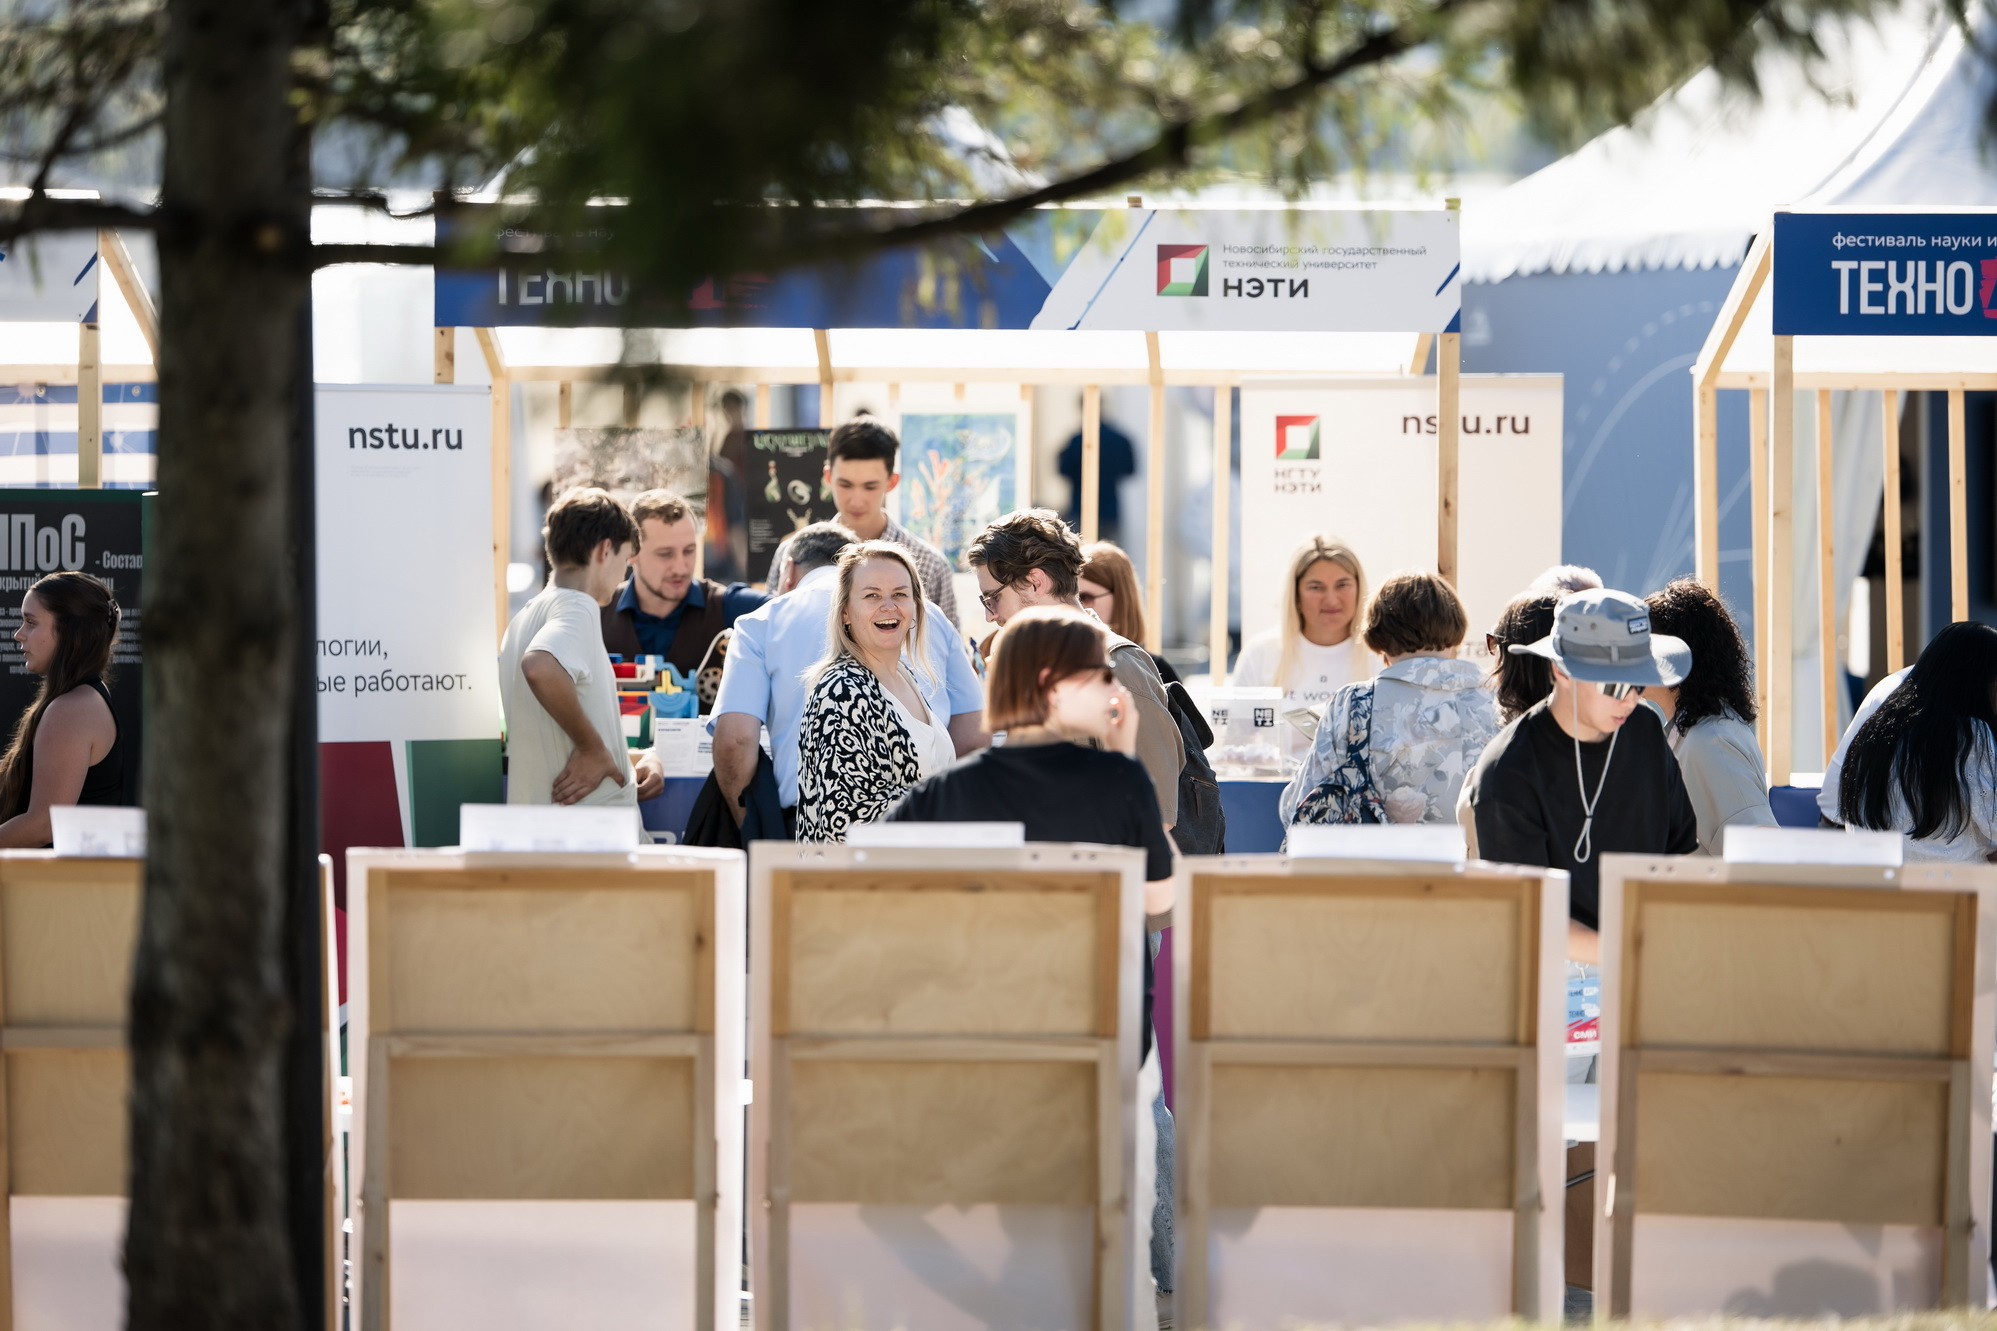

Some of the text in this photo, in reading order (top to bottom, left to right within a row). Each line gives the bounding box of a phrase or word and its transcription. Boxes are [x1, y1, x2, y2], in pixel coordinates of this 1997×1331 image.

[1222, 244, 1427, 256] Новосибирский государственный
[1832, 231, 1926, 250] фестиваль
[1931, 235, 1982, 251] науки
[1223, 259, 1378, 271] технический университет
[1223, 277, 1309, 298] НЭТИ
[1831, 260, 1974, 315] ТЕХНО
[1403, 415, 1530, 435] nsu.ru
[348, 423, 463, 450] nstu.ru
[1274, 469, 1320, 479] НГТУ
[1274, 483, 1322, 493] НЭТИ
[315, 639, 388, 660] логии,
[316, 669, 472, 698] ые работают.
